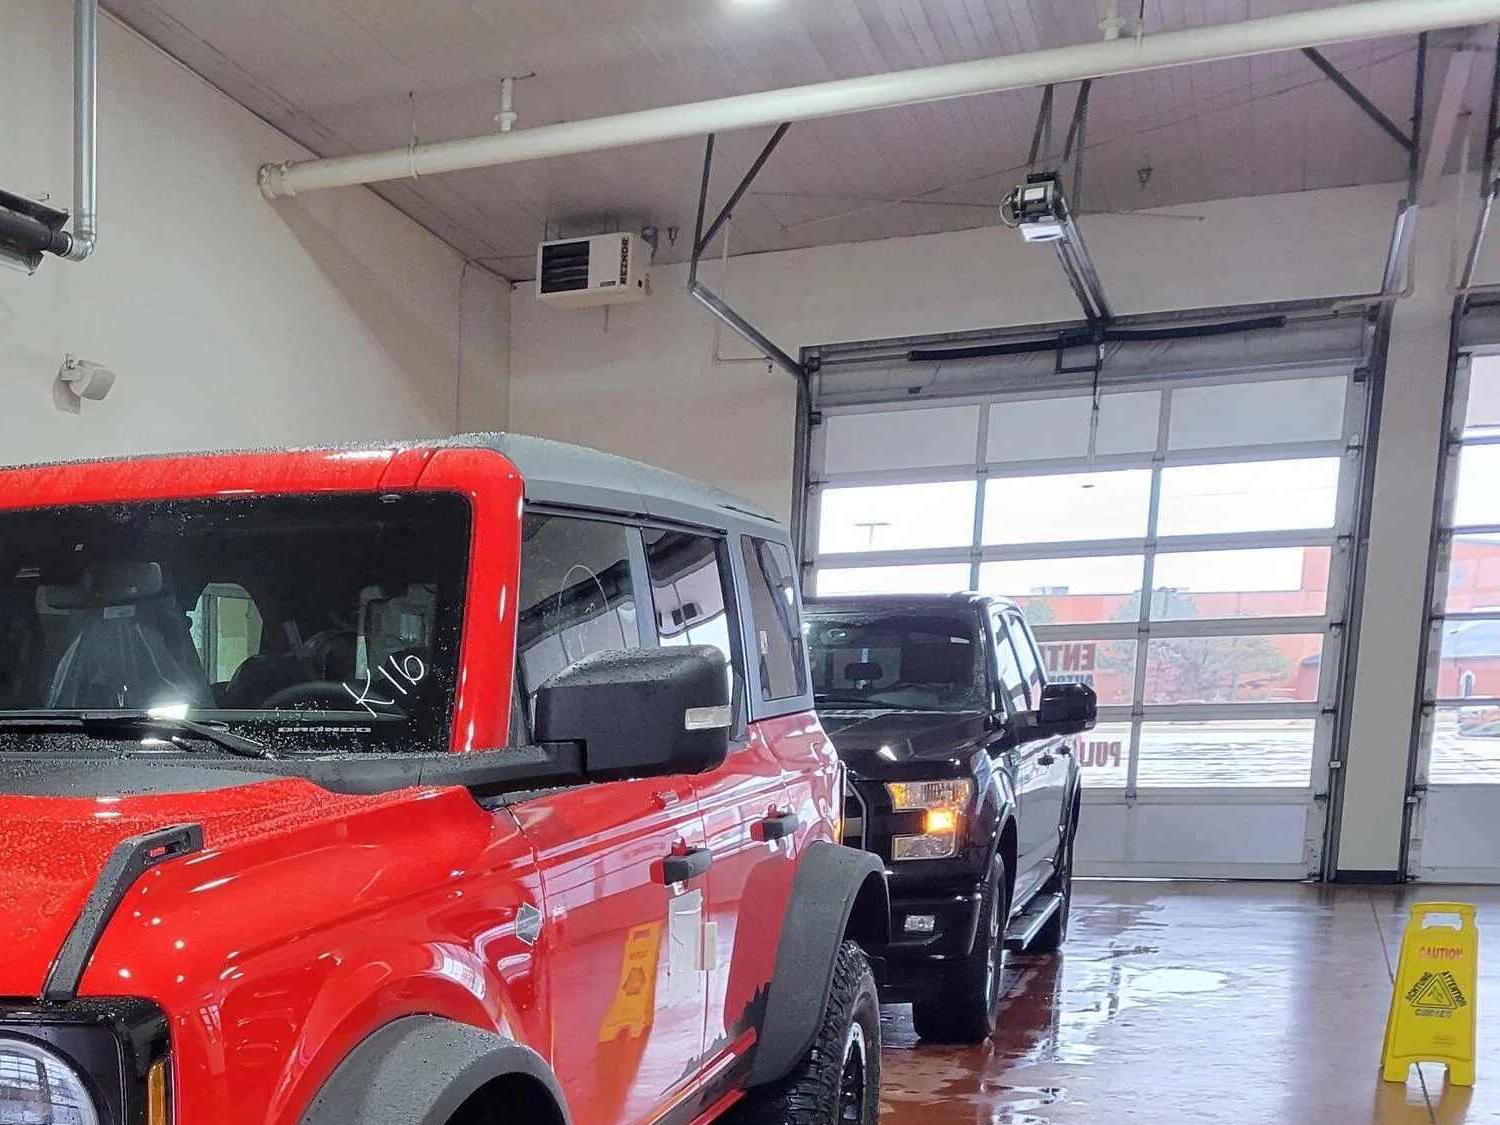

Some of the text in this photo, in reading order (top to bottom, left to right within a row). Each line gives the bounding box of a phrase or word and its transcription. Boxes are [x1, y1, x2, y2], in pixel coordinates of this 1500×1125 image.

[620, 238, 629, 284] REZNOR
[342, 654, 425, 719] K16
[1419, 946, 1463, 960] CAUTION
[1405, 971, 1433, 1002] ACHTUNG
[1440, 970, 1468, 1008] ATTENTION
